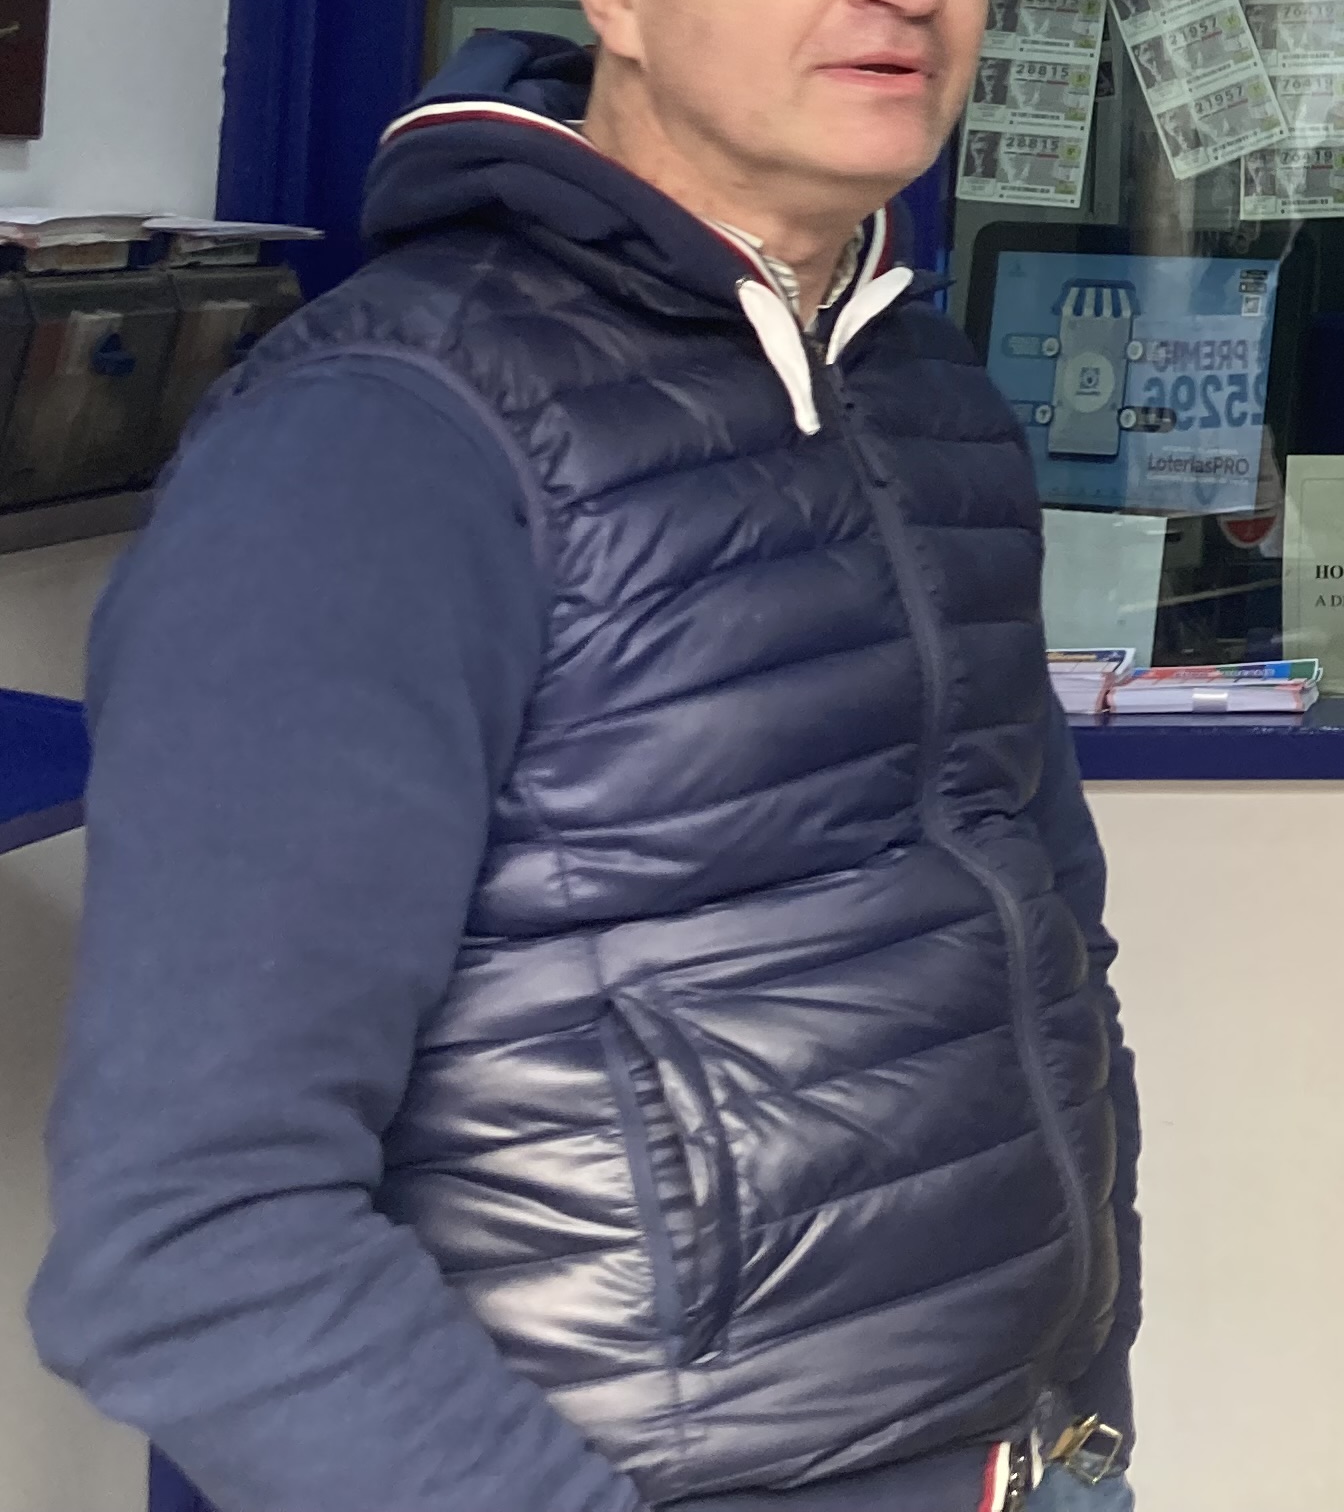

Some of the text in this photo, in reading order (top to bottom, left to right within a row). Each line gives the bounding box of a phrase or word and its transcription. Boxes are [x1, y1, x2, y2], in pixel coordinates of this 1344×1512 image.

[1015, 63, 1070, 78] 28815
[1005, 136, 1061, 151] 28815
[1315, 594, 1327, 607] A
